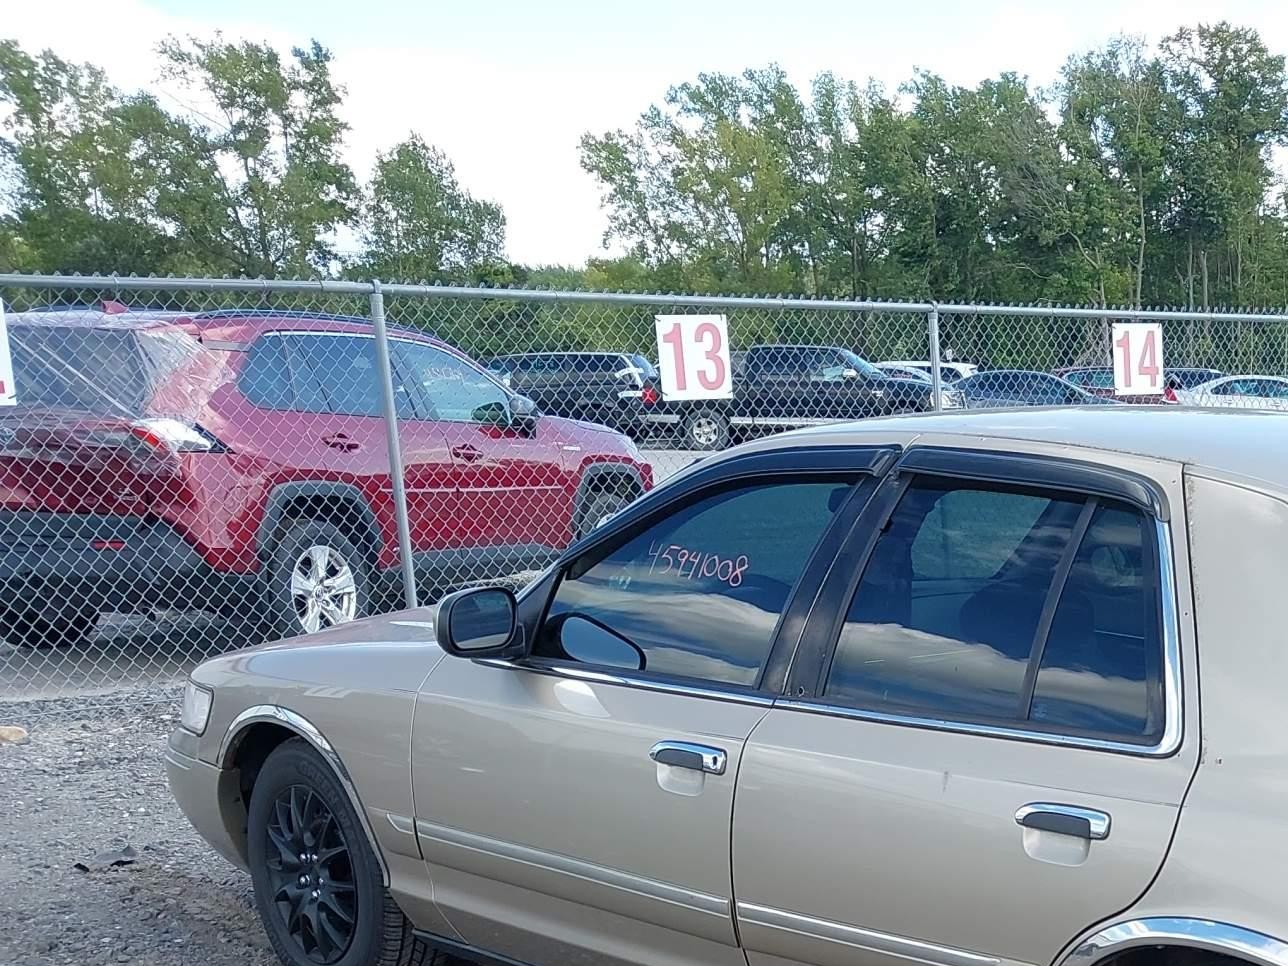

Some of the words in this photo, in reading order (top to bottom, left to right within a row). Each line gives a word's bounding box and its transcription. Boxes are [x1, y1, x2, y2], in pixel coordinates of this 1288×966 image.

[662, 322, 726, 391] 13
[1116, 330, 1159, 388] 14
[648, 539, 749, 587] 45941008
